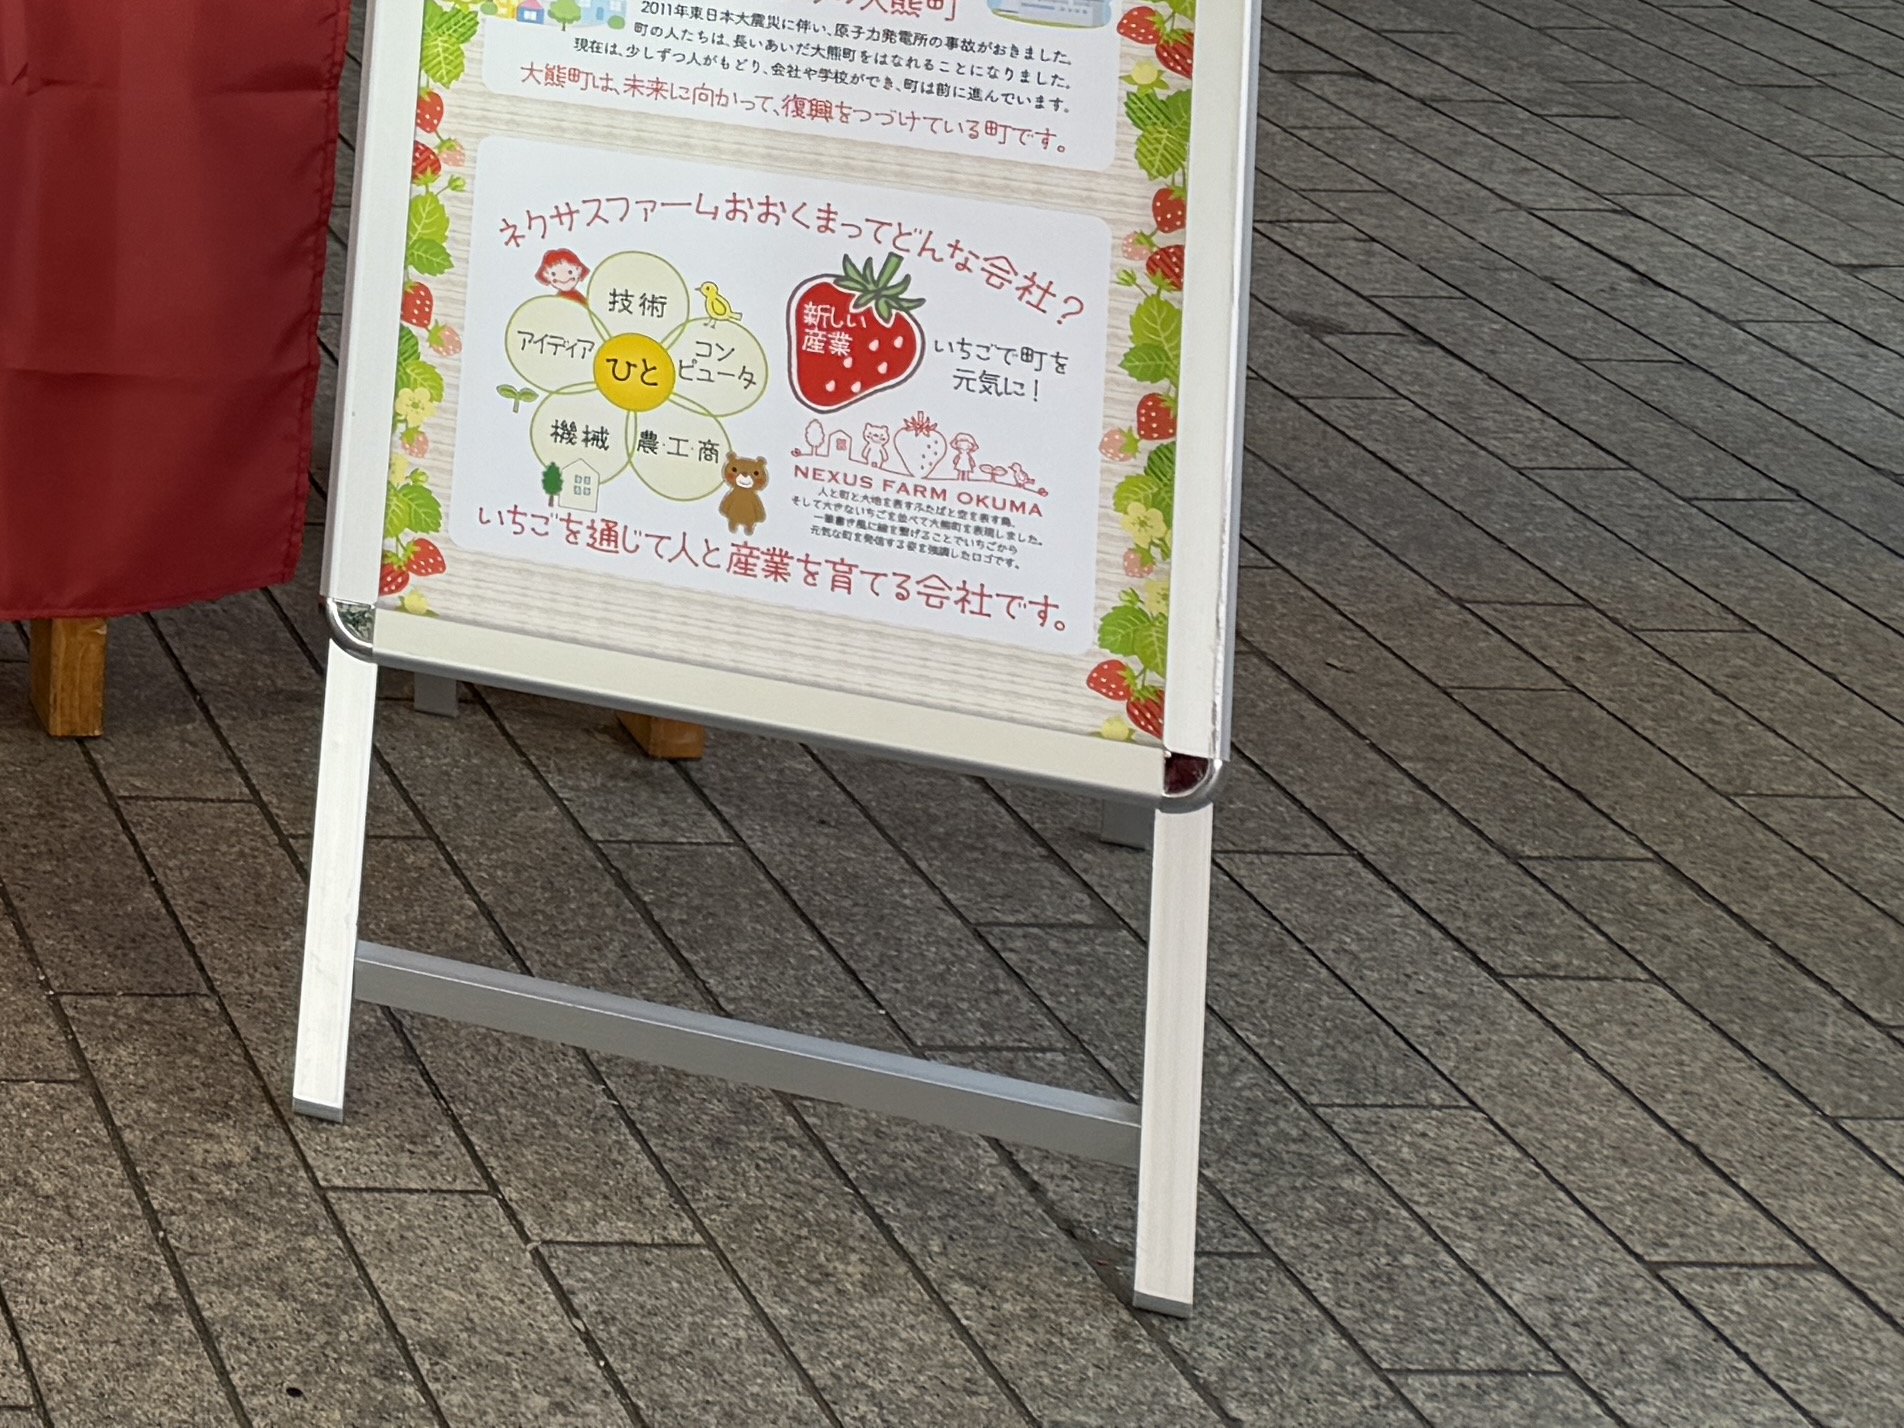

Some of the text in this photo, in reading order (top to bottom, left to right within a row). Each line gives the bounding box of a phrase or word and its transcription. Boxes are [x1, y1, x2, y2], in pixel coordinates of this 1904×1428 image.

[634, 22, 1071, 89] 町の人たちは、長いあいだ大熊町をはなれることになりました。
[521, 61, 1066, 153] 大熊町は、未来に向かって、復興をつづけている町です。
[499, 190, 1087, 325] ネクサスファームおおくまってどんな会社？
[609, 288, 668, 318] 技術
[803, 300, 868, 331] 新しい
[517, 329, 595, 358] アイディア
[695, 340, 735, 363] コン
[801, 329, 851, 358] 産業
[934, 337, 1070, 376] いちごで町を
[607, 355, 659, 385] ひと
[677, 360, 758, 389] ピュータ
[550, 419, 610, 453] 機械
[794, 465, 1043, 517] NEXUS FARM OKUMA
[478, 503, 1068, 634] いちごを通じて人と産業を育てる会社です。
